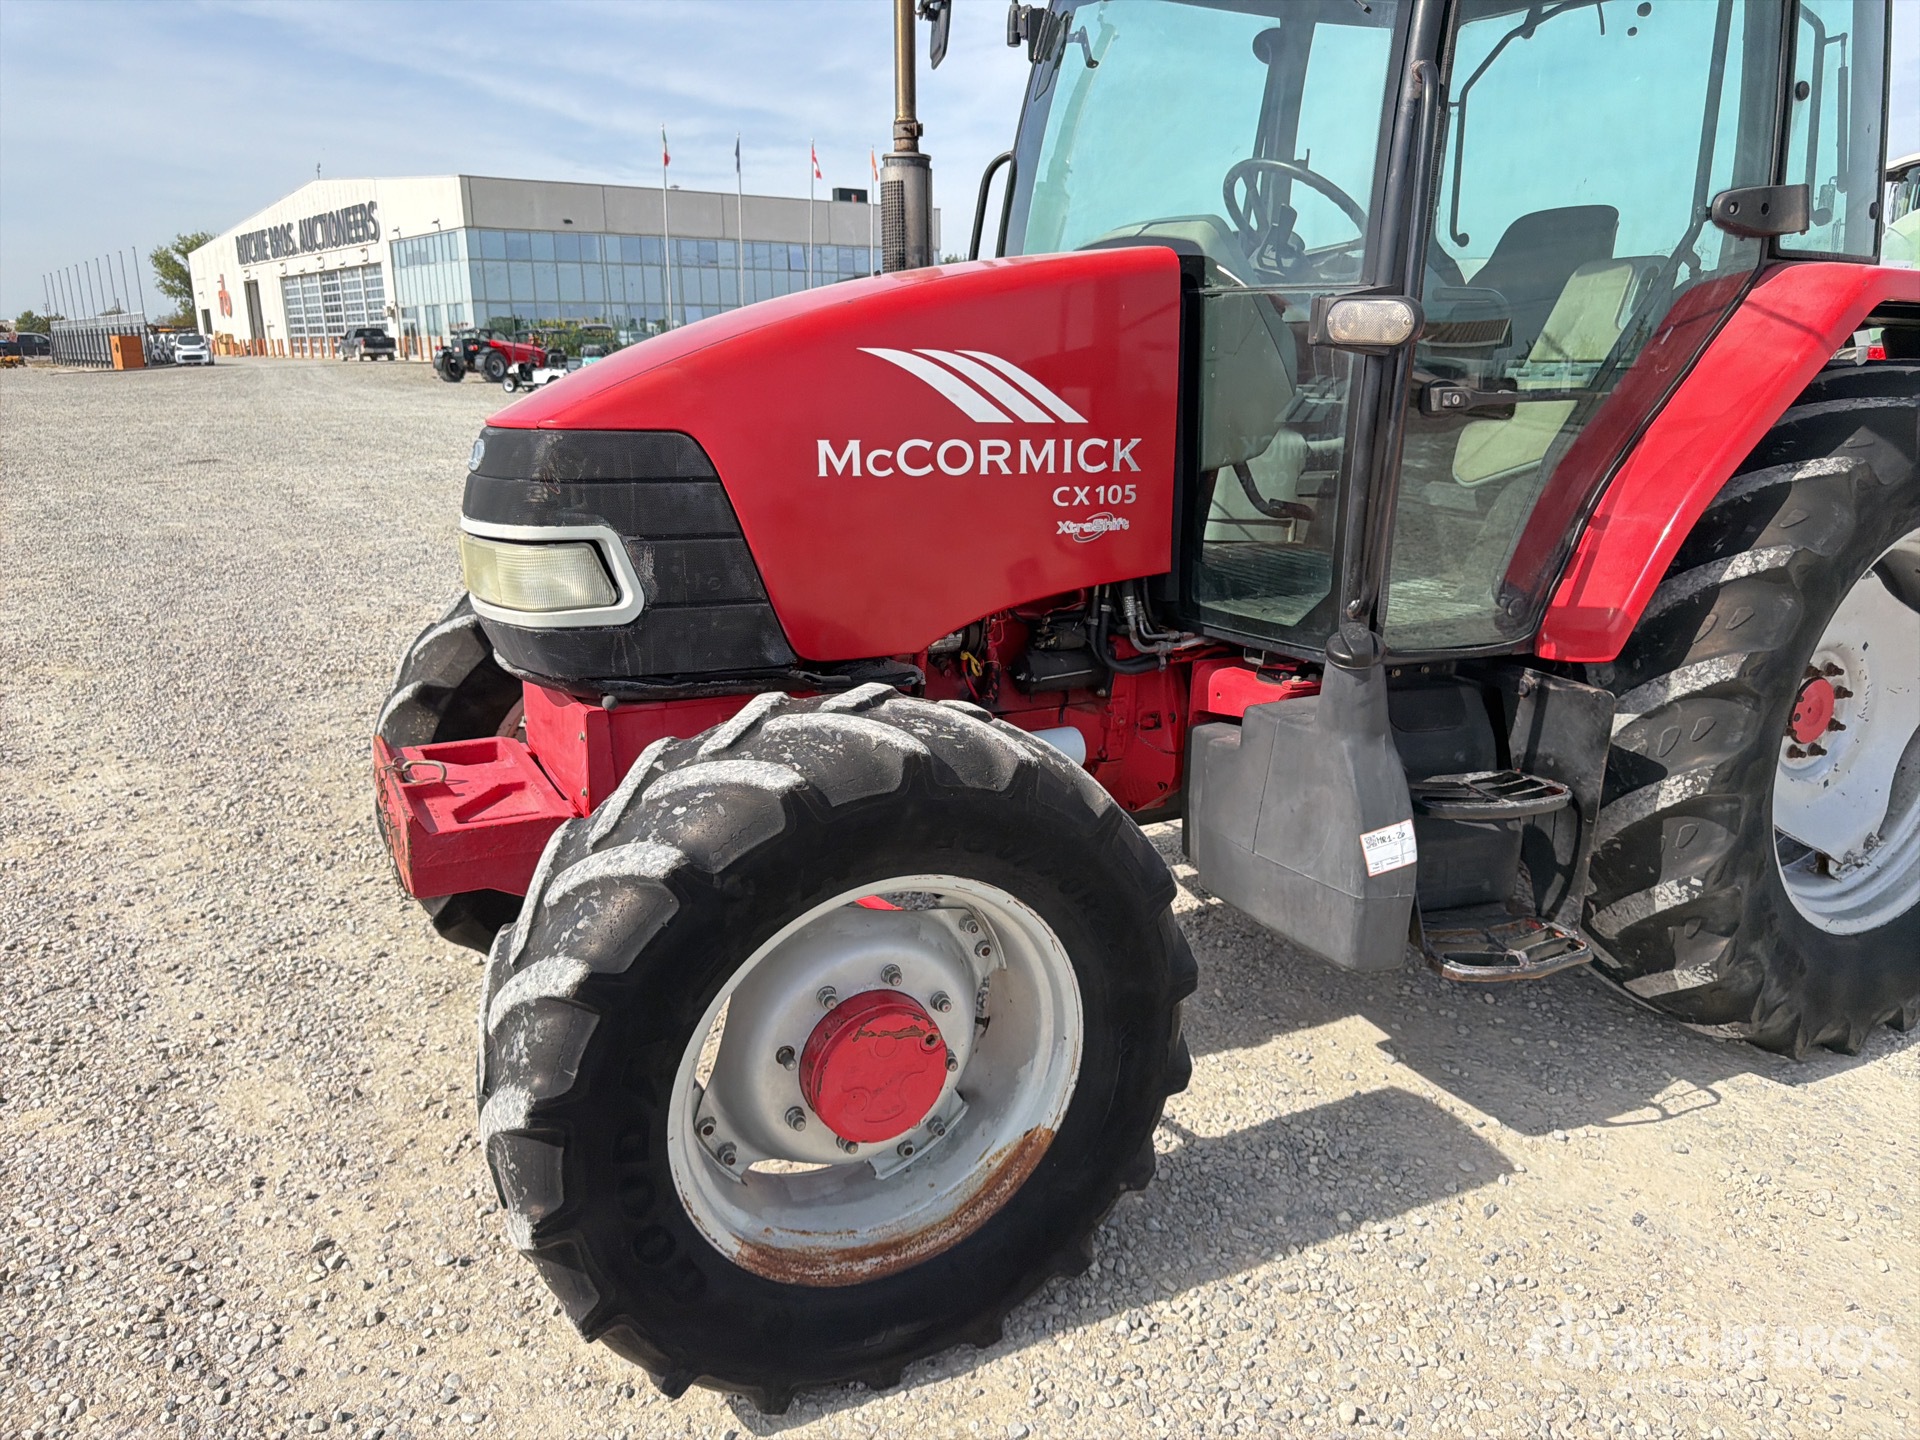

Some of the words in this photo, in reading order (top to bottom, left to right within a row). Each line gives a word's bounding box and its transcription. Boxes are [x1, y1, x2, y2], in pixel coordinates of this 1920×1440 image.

[235, 229, 270, 265] RITCHIE
[299, 200, 381, 253] AUCTIONEERS
[816, 438, 1143, 477] McCORMICK
